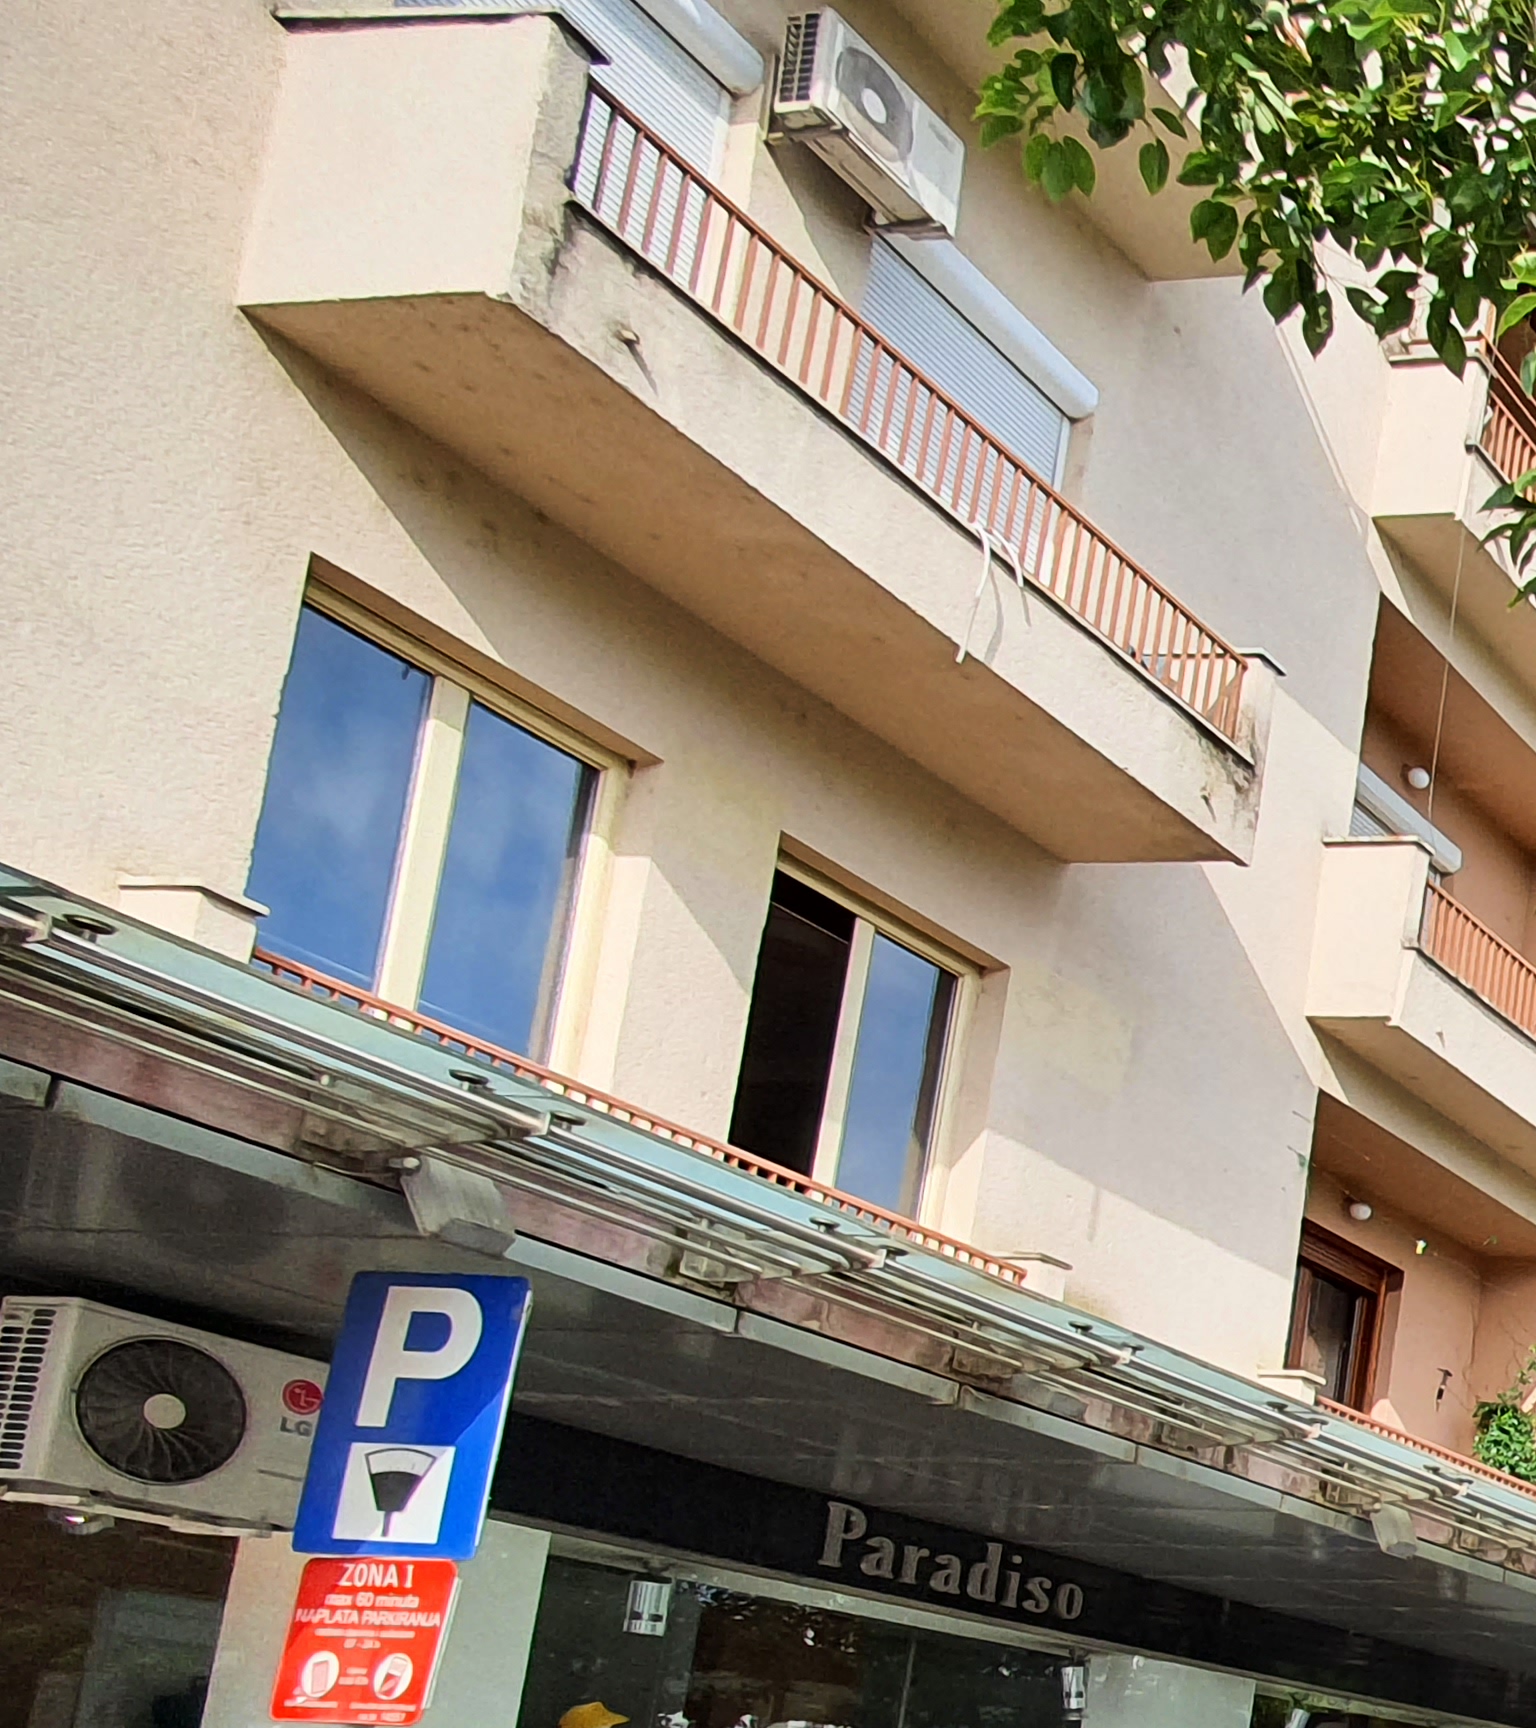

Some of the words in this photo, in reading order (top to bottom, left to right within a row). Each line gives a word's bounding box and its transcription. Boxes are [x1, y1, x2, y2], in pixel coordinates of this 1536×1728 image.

[355, 1286, 483, 1427] P
[280, 1416, 313, 1438] LG
[816, 1501, 1083, 1620] Paradiso
[338, 1563, 398, 1588] ZONA
[404, 1565, 414, 1588] I
[324, 1594, 352, 1606] max
[355, 1591, 374, 1607] 60
[295, 1608, 360, 1625] NAPLATA
[361, 1610, 441, 1627] PARKIRANJA
